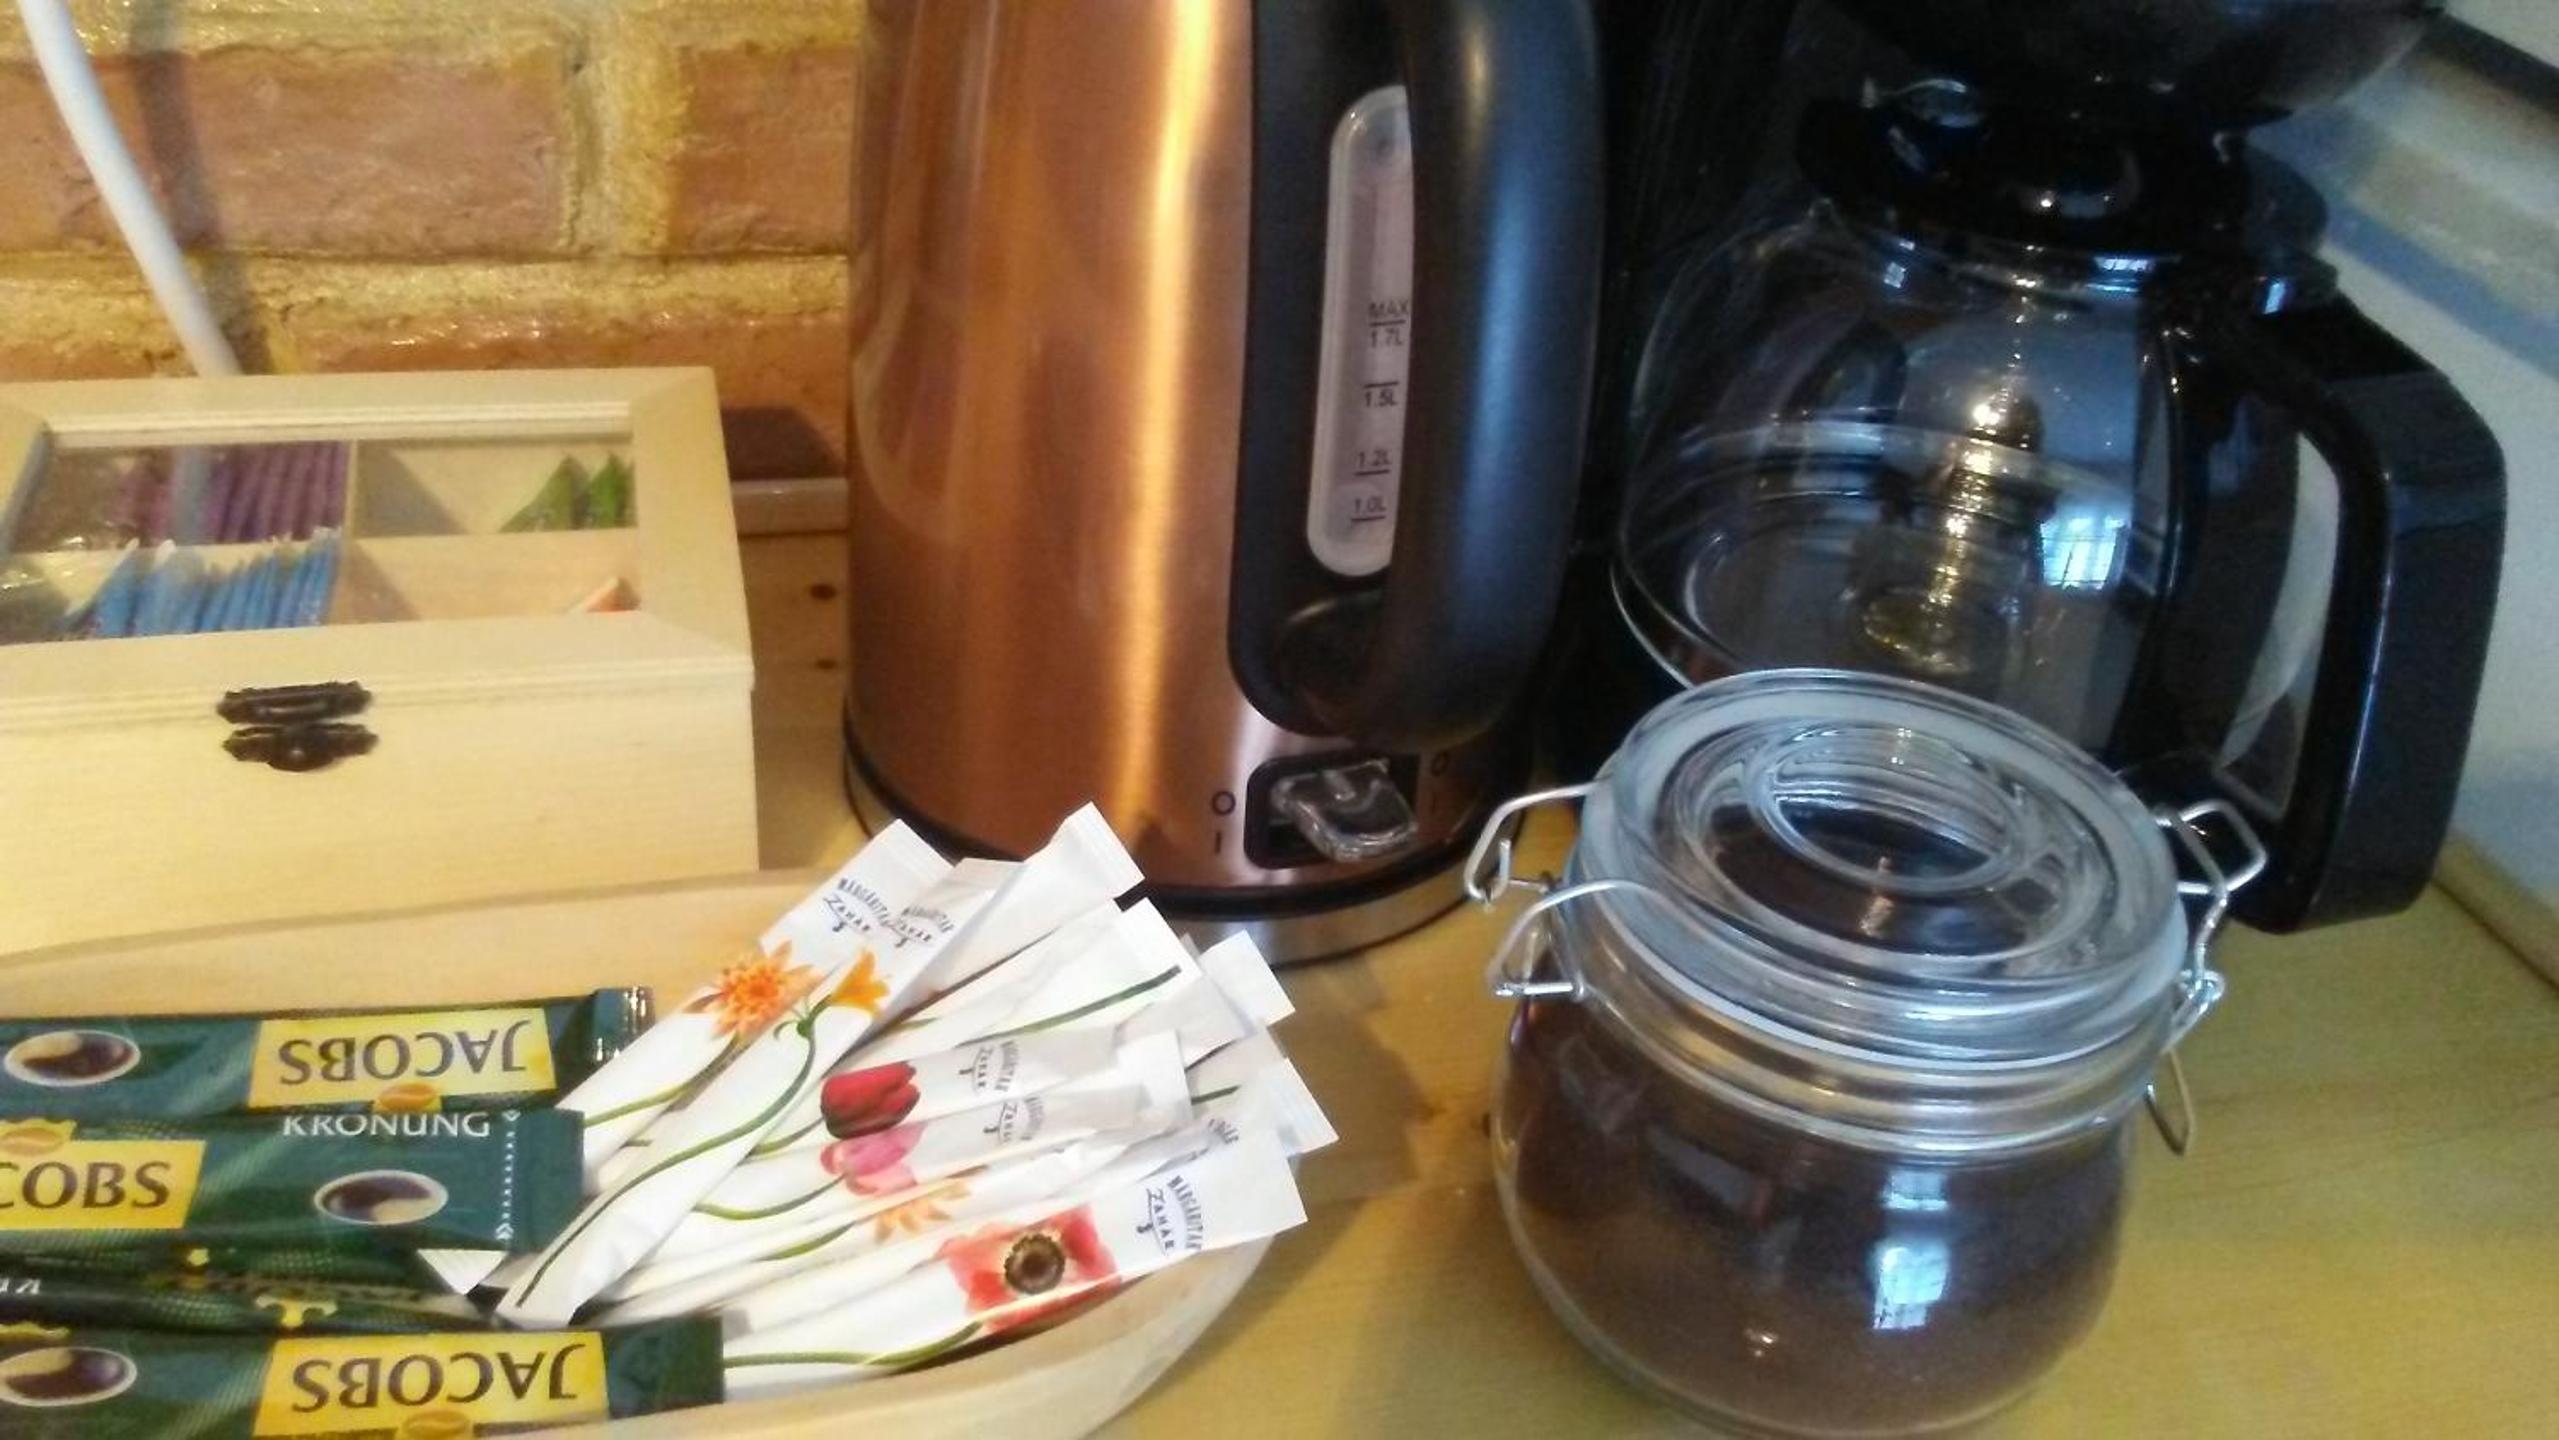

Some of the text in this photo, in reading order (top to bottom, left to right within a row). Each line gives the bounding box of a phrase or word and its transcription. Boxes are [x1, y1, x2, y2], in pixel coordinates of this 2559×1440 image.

[1368, 302, 1409, 318] MAX
[1370, 328, 1403, 348] 1.7L
[1364, 389, 1397, 407] 1.5L
[1354, 497, 1387, 513] 1.0L
[279, 1019, 534, 1087] JACOBS
[292, 1342, 588, 1414] JACOBS
